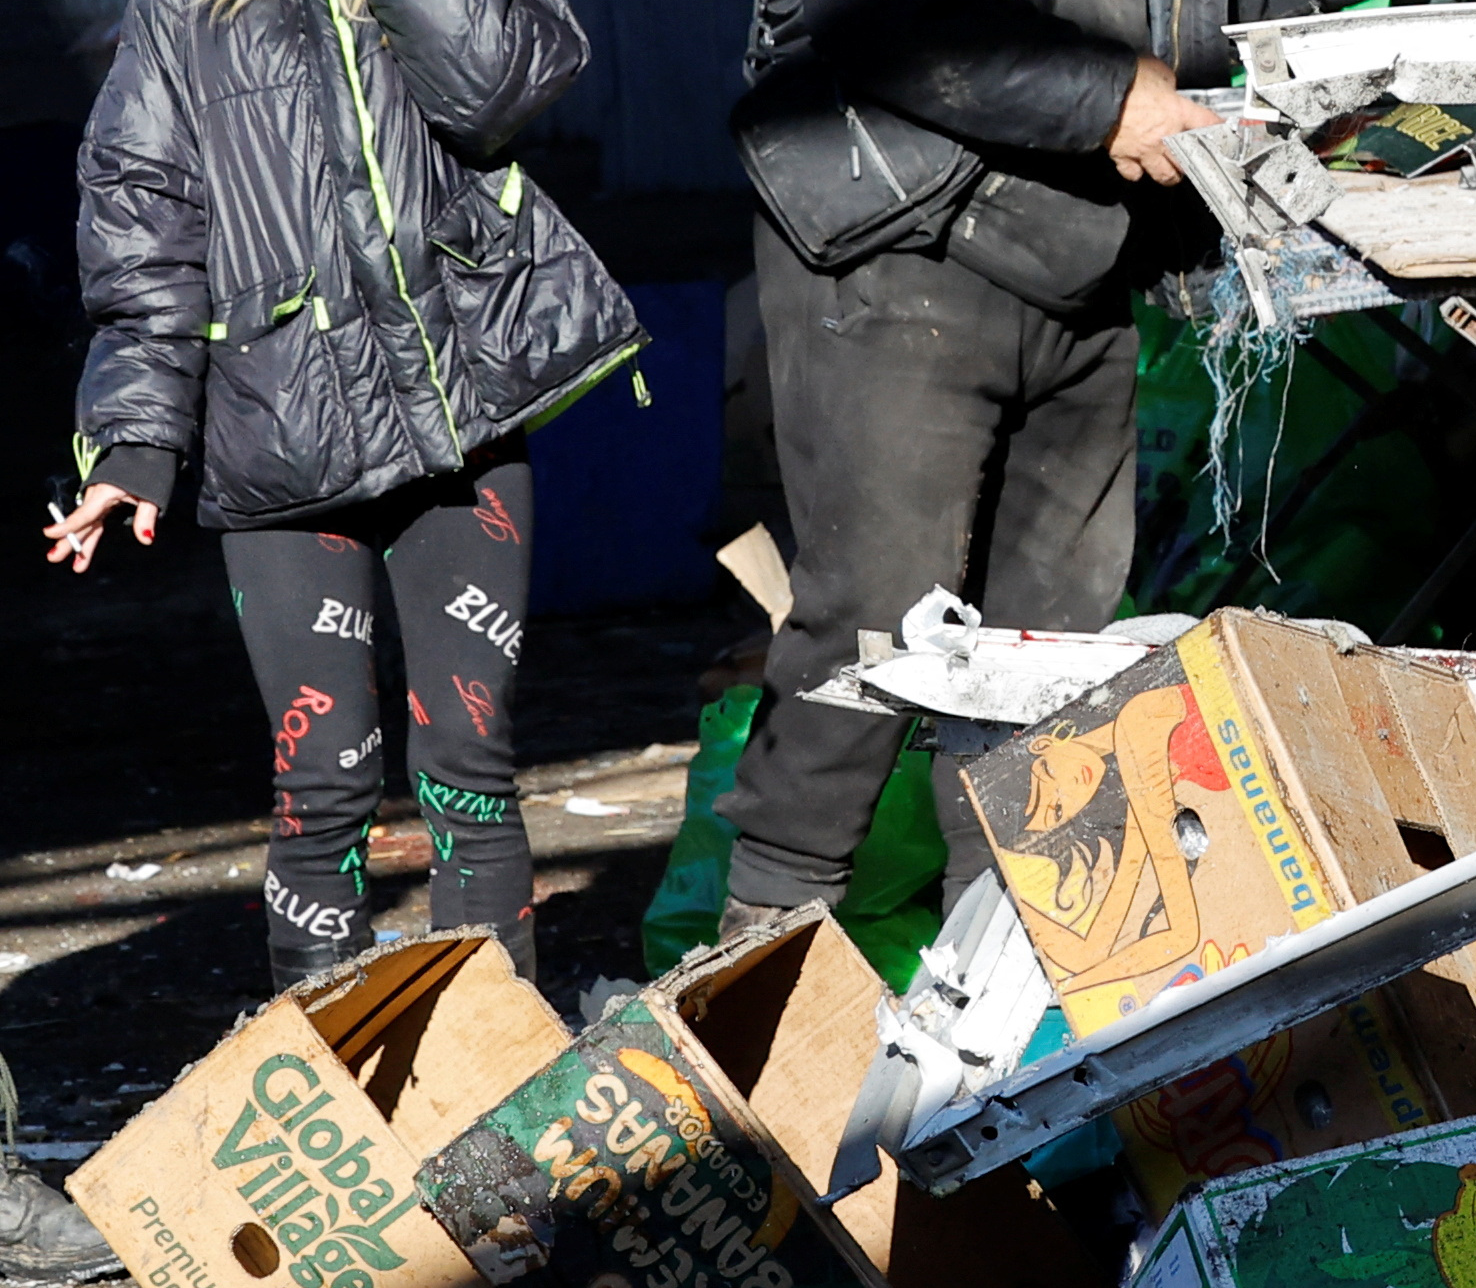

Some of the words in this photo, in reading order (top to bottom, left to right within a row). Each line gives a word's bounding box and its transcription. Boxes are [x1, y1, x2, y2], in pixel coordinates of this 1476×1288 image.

[445, 583, 525, 666] BLUE
[1215, 716, 1317, 914] bananas
[263, 869, 356, 941] BLUES
[1352, 995, 1424, 1125] prem
[251, 1053, 424, 1229] Global
[664, 1095, 773, 1215] ECUADOR
